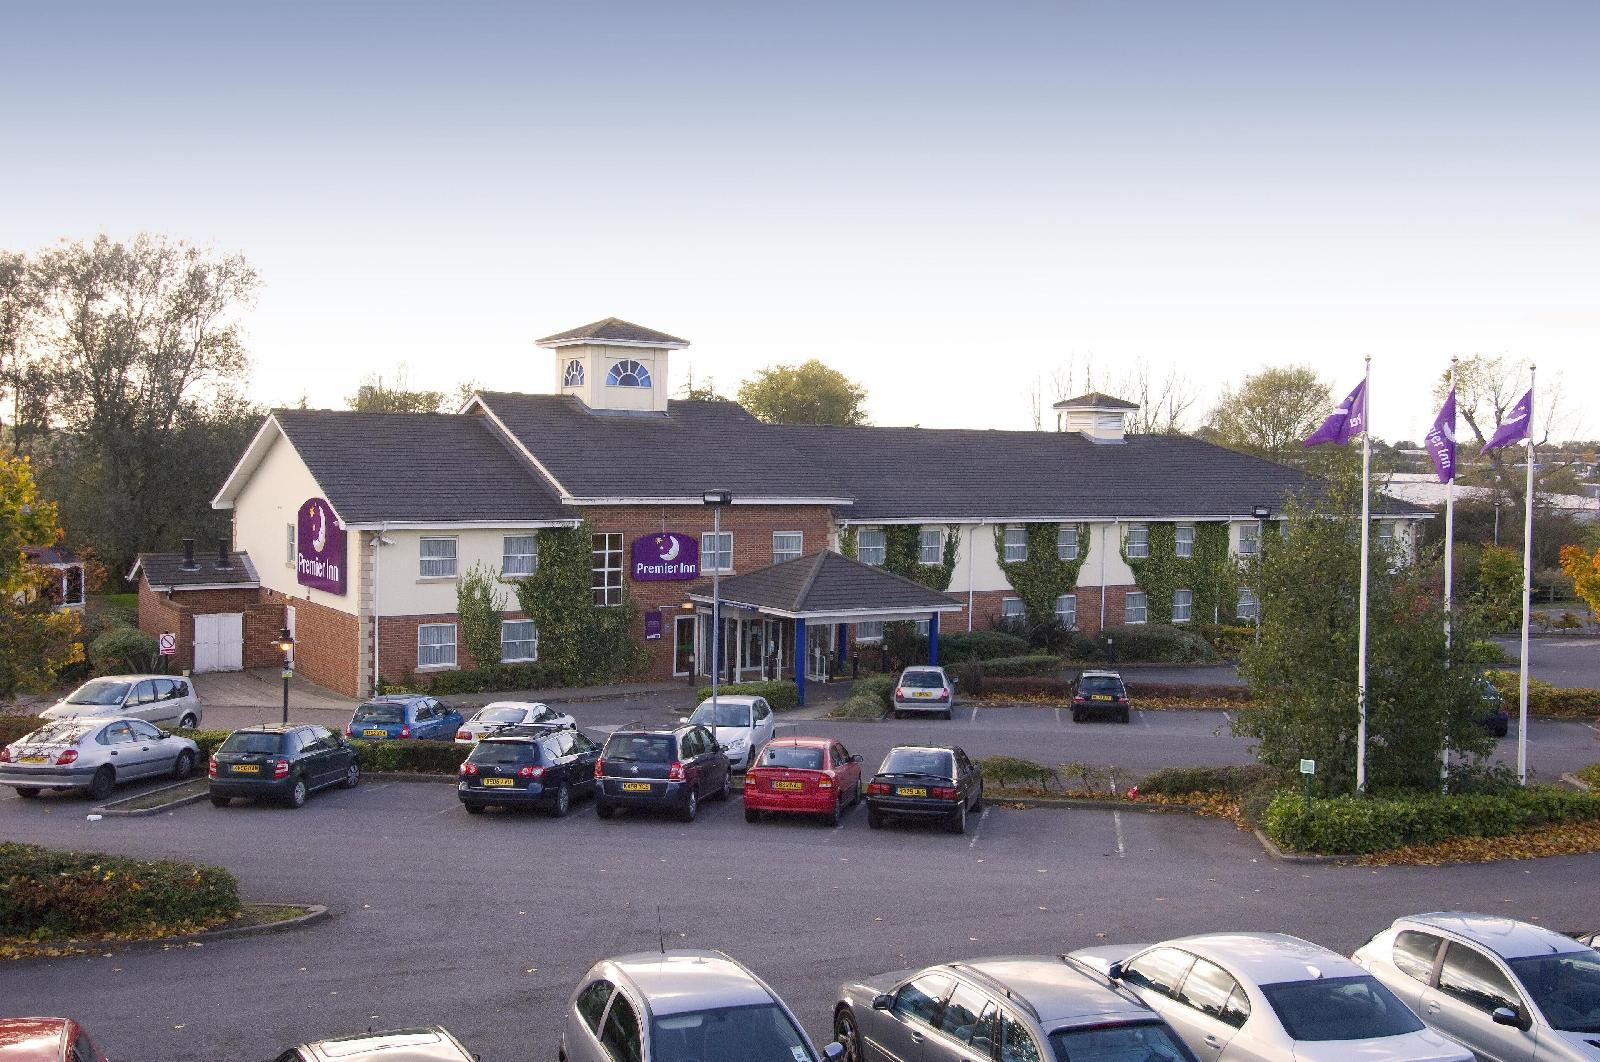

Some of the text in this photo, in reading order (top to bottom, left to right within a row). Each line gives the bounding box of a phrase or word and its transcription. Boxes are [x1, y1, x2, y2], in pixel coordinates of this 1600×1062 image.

[298, 552, 339, 582] Premier Inn
[636, 562, 696, 574] Premier Inn
